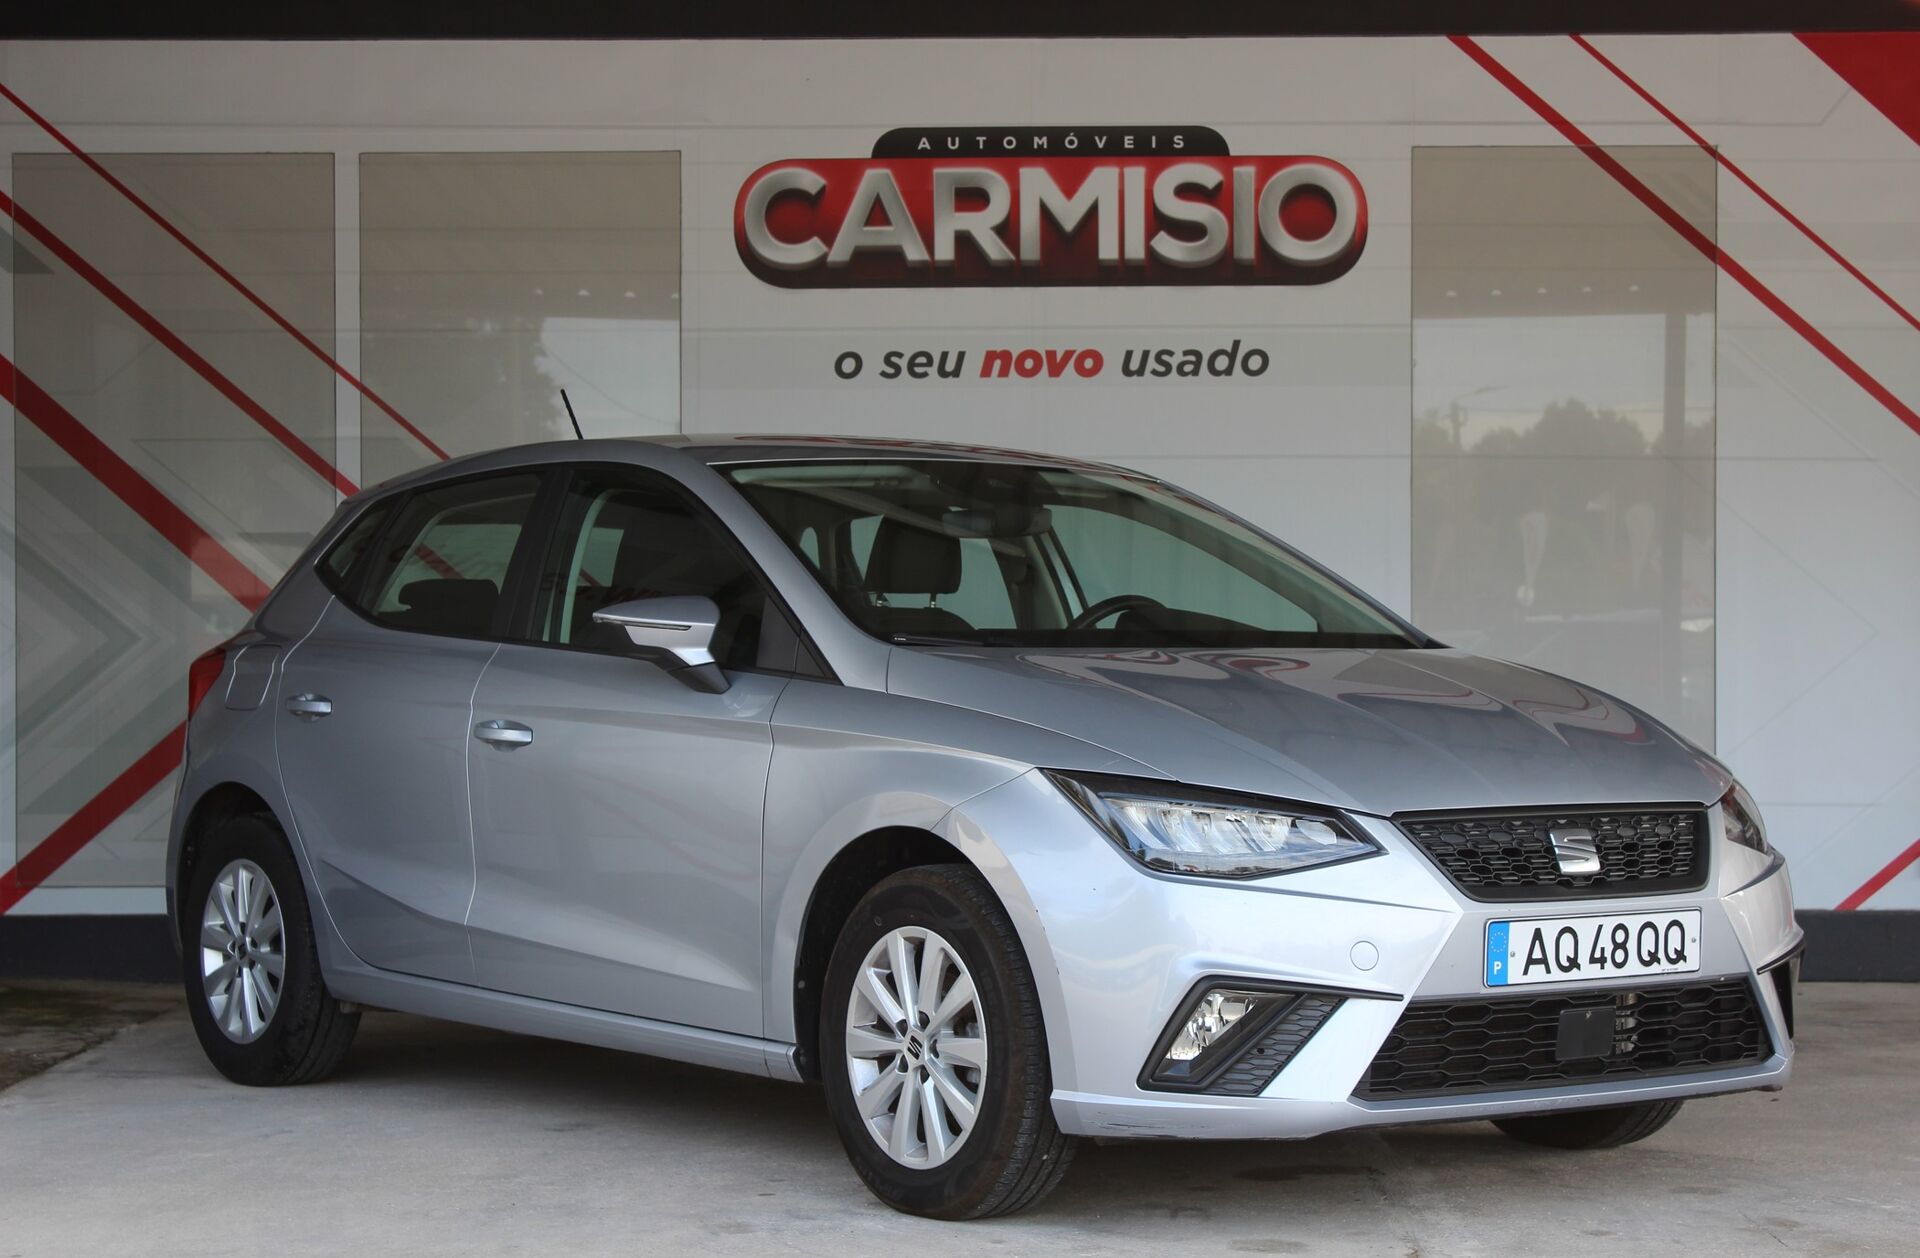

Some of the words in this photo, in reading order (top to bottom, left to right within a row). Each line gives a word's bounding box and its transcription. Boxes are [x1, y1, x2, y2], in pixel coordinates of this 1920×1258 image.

[917, 132, 1185, 149] AUTOMÓVEIS
[743, 163, 1360, 268] CARMISIO
[833, 351, 863, 379] o
[879, 350, 966, 379] seu
[979, 348, 1104, 379] novo
[1120, 339, 1270, 379] usado
[1522, 926, 1581, 976] AQ
[1588, 922, 1630, 970] 48
[1636, 919, 1687, 968] QQ
[1493, 961, 1502, 975] P
